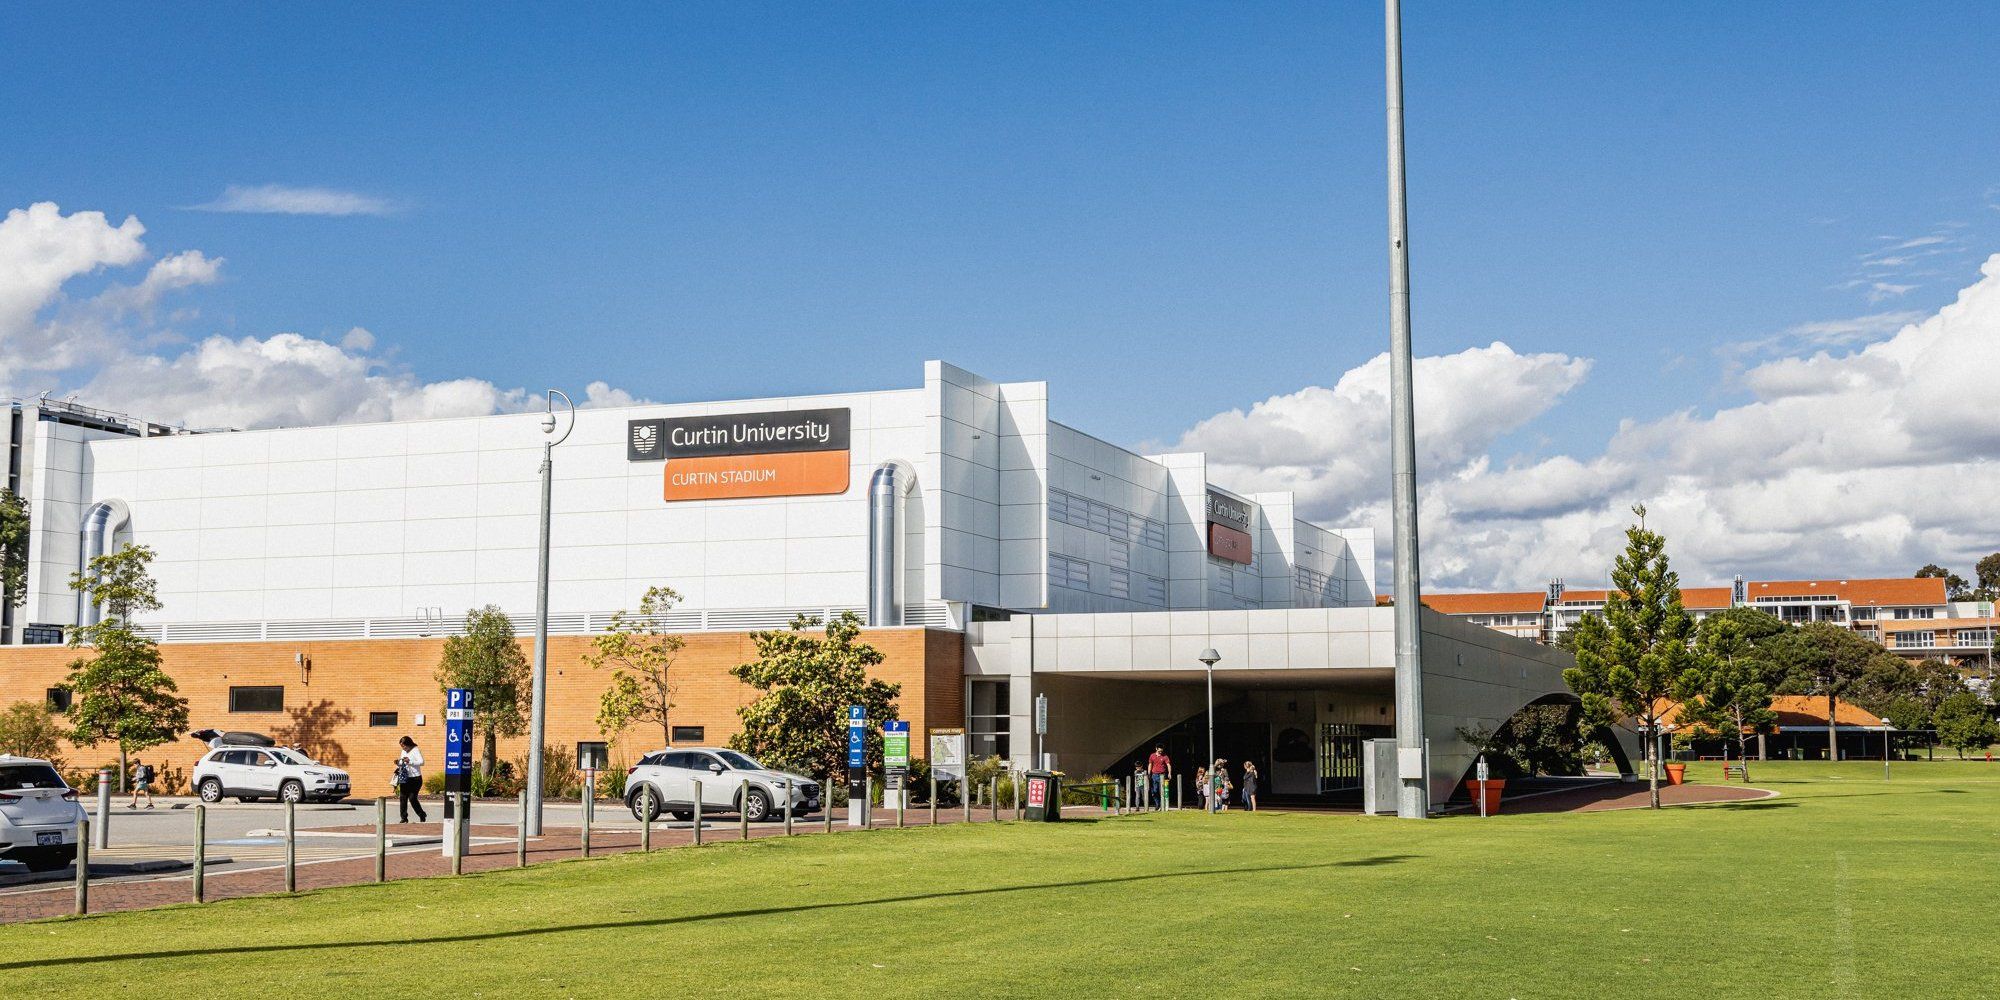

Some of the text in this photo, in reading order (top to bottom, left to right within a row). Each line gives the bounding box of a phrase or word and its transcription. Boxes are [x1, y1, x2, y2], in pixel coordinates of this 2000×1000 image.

[671, 421, 830, 446] Curtin University
[671, 469, 776, 486] CURTIN STADIUM
[1214, 500, 1228, 517] Curtin
[451, 691, 460, 708] P
[465, 691, 472, 708] P
[853, 708, 860, 718] P
[893, 722, 899, 731] P
